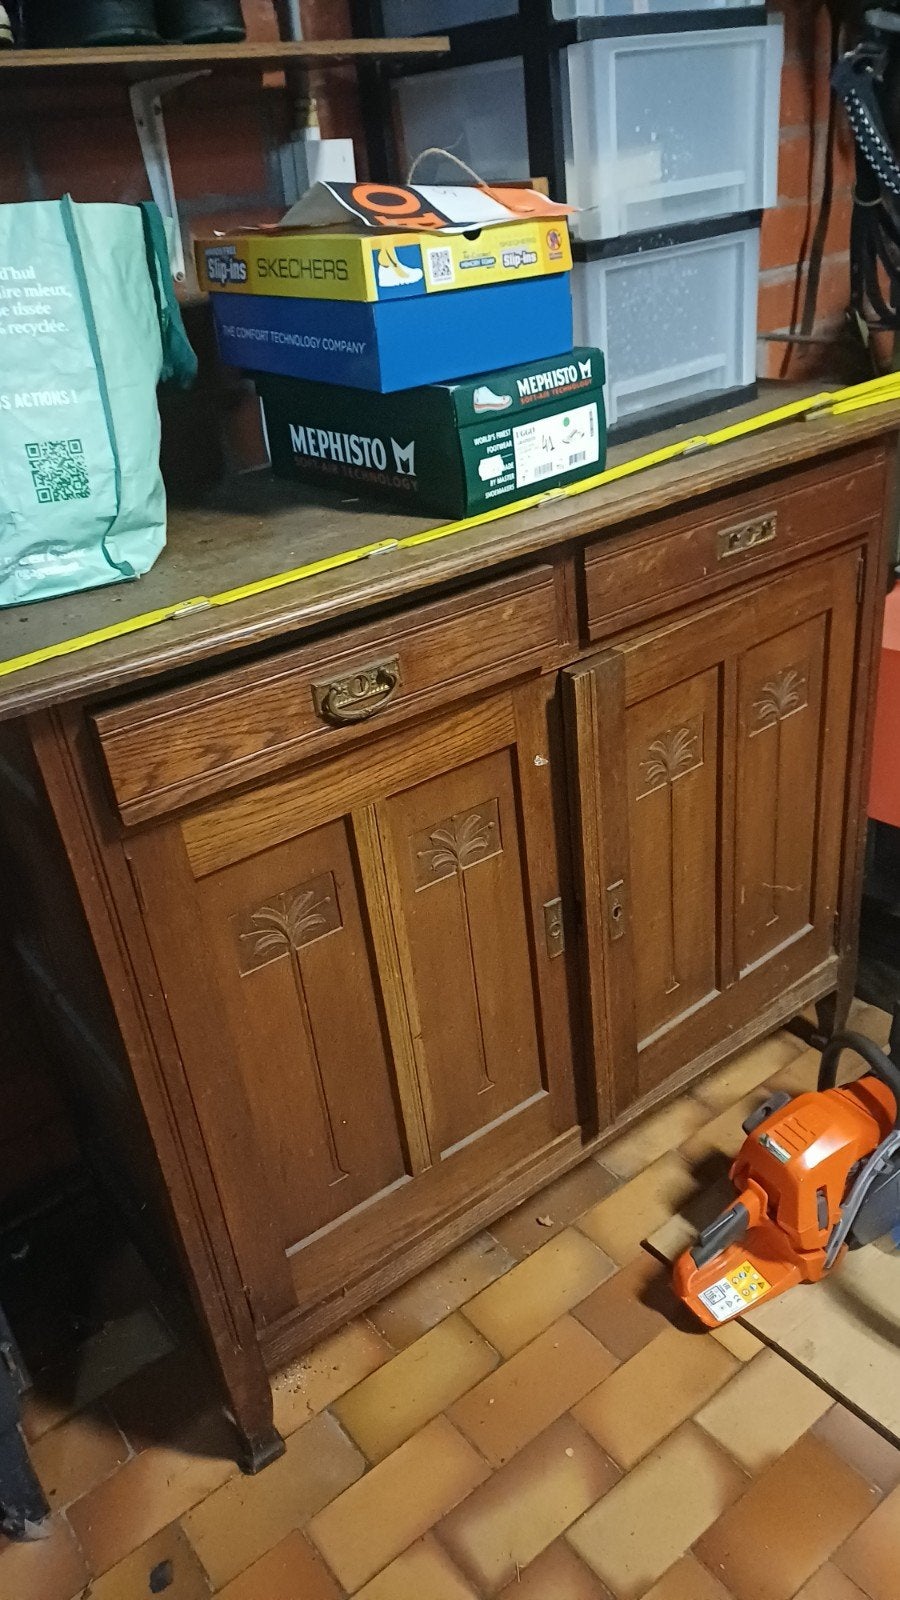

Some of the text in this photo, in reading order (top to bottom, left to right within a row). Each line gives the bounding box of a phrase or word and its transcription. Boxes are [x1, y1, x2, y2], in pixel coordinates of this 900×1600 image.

[257, 258, 348, 281] SKECHERS
[24, 283, 72, 298] mieux,
[8, 319, 69, 337] recyclée.
[222, 325, 367, 355] THE COMFORT TECHNOLOGY COMPANY
[517, 364, 578, 397] MEPHISTO
[15, 389, 70, 409] ACTIONS
[289, 423, 387, 471] MEPHISTO
[473, 434, 496, 446] WORLD'S
[496, 428, 511, 441] FINEST
[486, 440, 513, 455] FOOTWEAR
